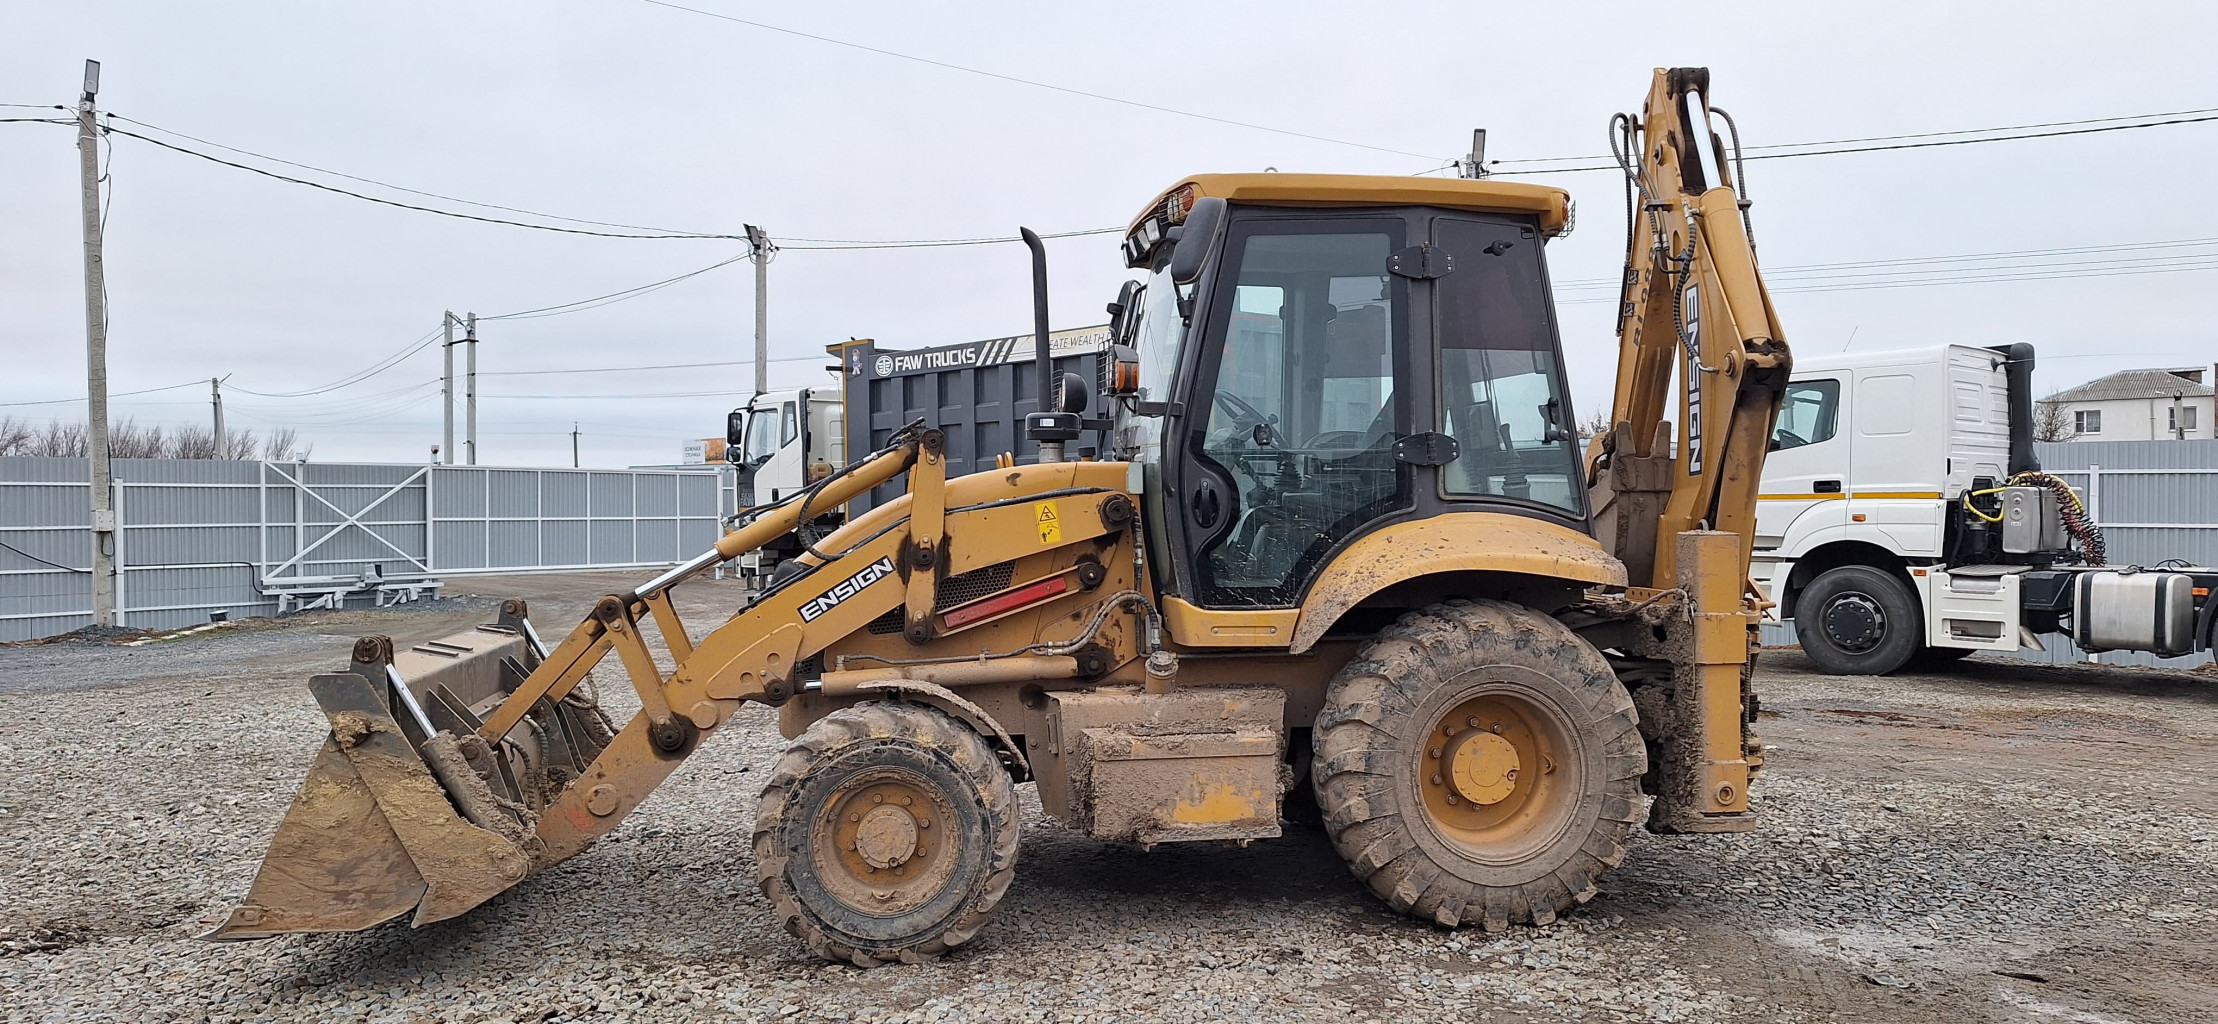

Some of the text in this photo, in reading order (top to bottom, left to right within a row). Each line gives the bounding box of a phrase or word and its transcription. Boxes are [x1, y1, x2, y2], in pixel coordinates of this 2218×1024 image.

[895, 347, 976, 372] FAW TRUCKS
[1070, 333, 1104, 347] WEALTH
[1686, 286, 1701, 473] ENSIGN
[800, 558, 893, 621] ENSIGN
